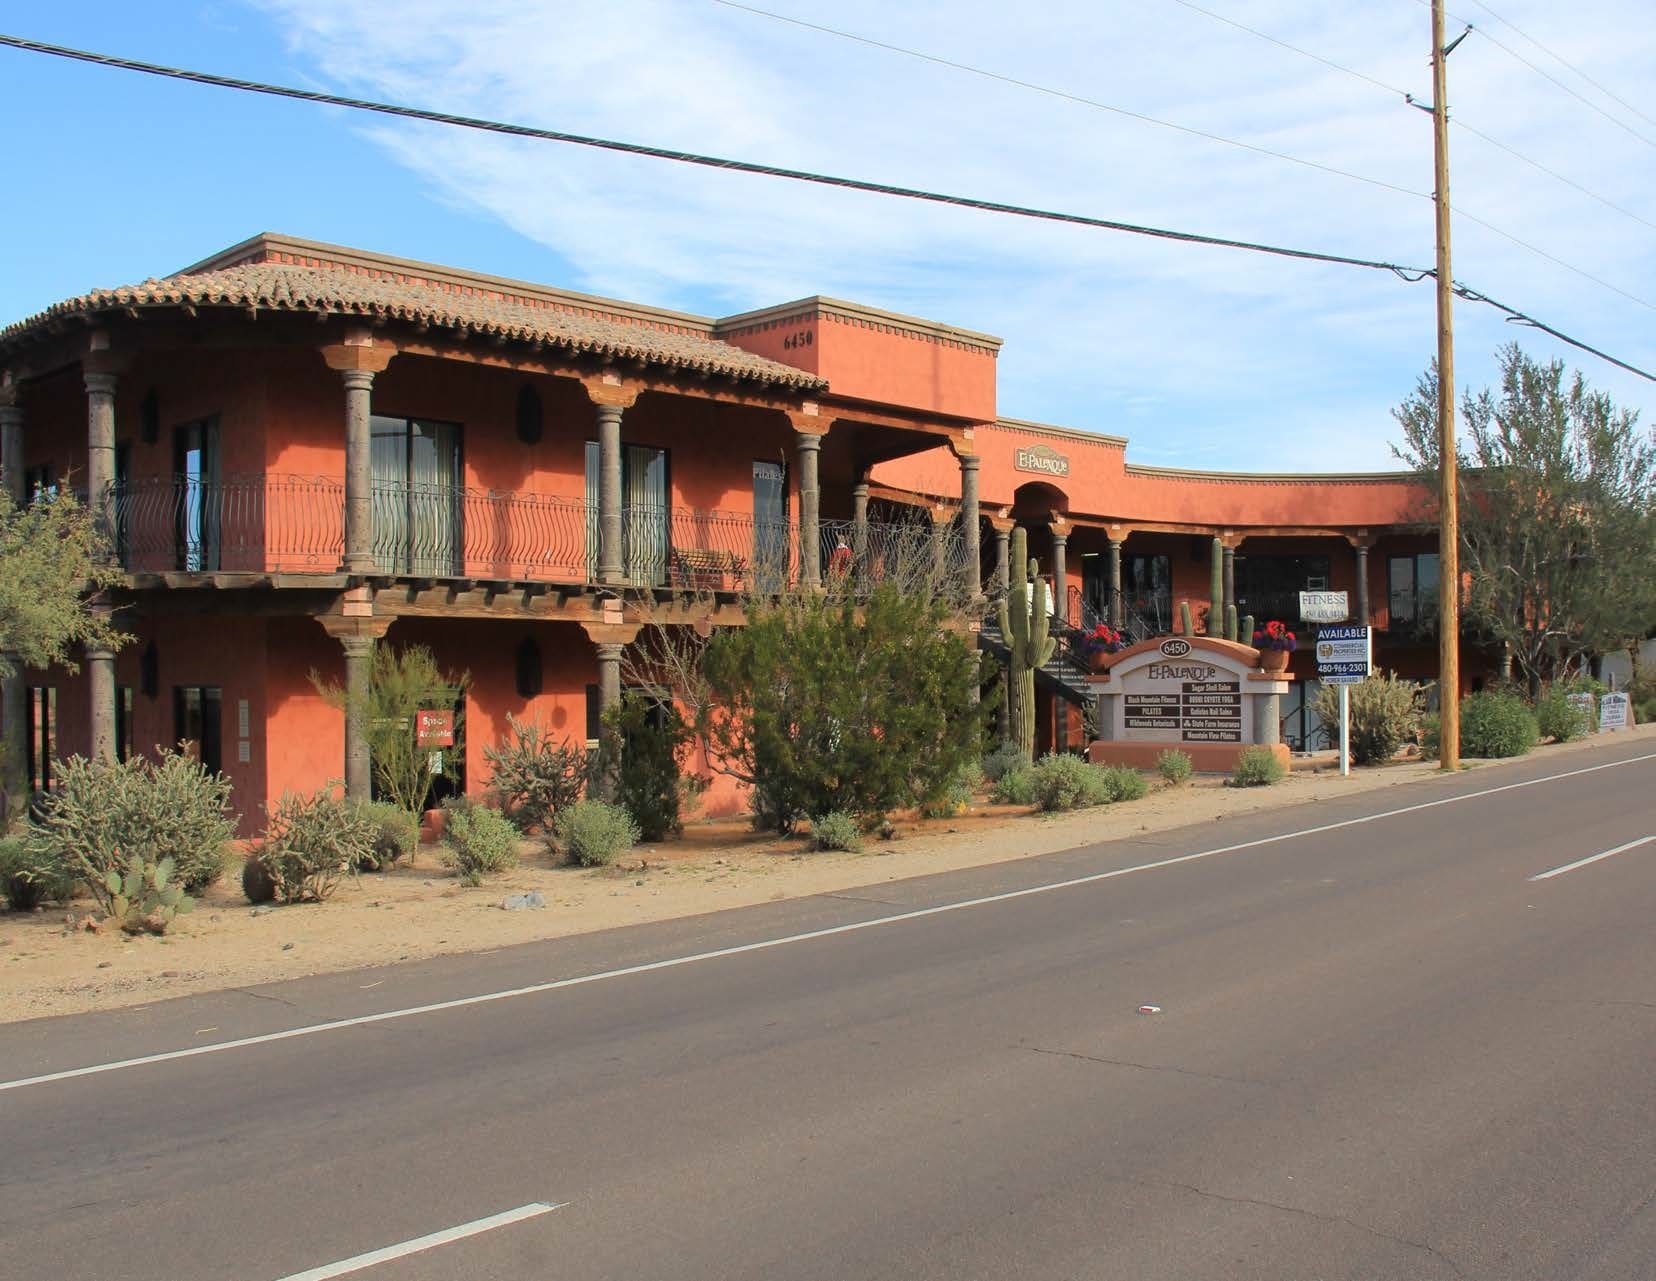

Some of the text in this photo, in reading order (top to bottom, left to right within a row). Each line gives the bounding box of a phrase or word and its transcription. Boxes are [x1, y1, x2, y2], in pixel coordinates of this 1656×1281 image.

[784, 330, 813, 350] 6450
[1302, 594, 1346, 605] FITNESS
[1318, 627, 1367, 639] AVAILABLE
[1164, 642, 1188, 654] 6450
[1318, 663, 1367, 672] 480-966-2301
[1140, 696, 1160, 704] Mountain
[1204, 696, 1221, 704] COYOTE
[1142, 707, 1162, 715] PILATES
[1192, 719, 1240, 728] State Farm Insurance
[1187, 731, 1208, 740] Mountain
